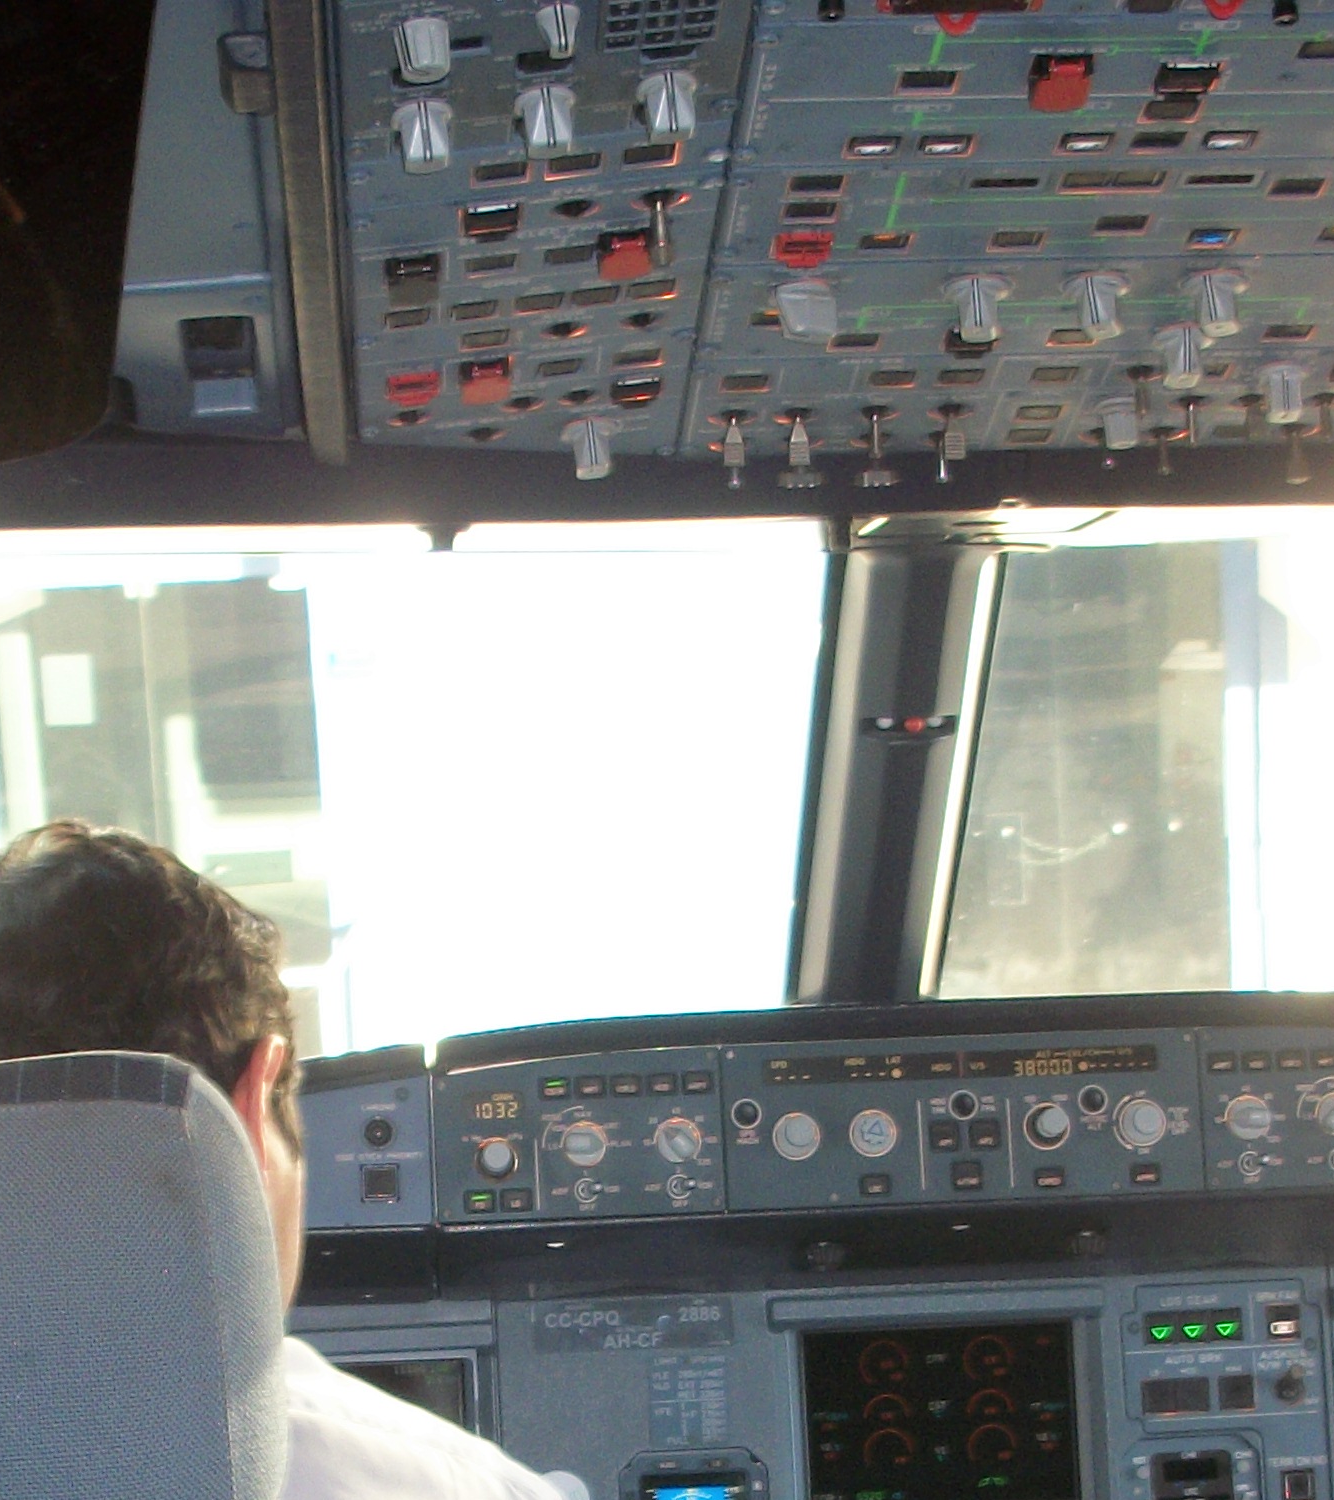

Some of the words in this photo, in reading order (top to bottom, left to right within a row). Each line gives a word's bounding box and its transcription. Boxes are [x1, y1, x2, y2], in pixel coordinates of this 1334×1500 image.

[1013, 1058, 1074, 1077] 38000
[473, 1101, 519, 1119] 1032
[544, 1310, 620, 1328] CC-CPQ
[677, 1306, 721, 1322] 2886
[603, 1332, 663, 1350] AH-CF
[1164, 1354, 1196, 1365] AUTO
